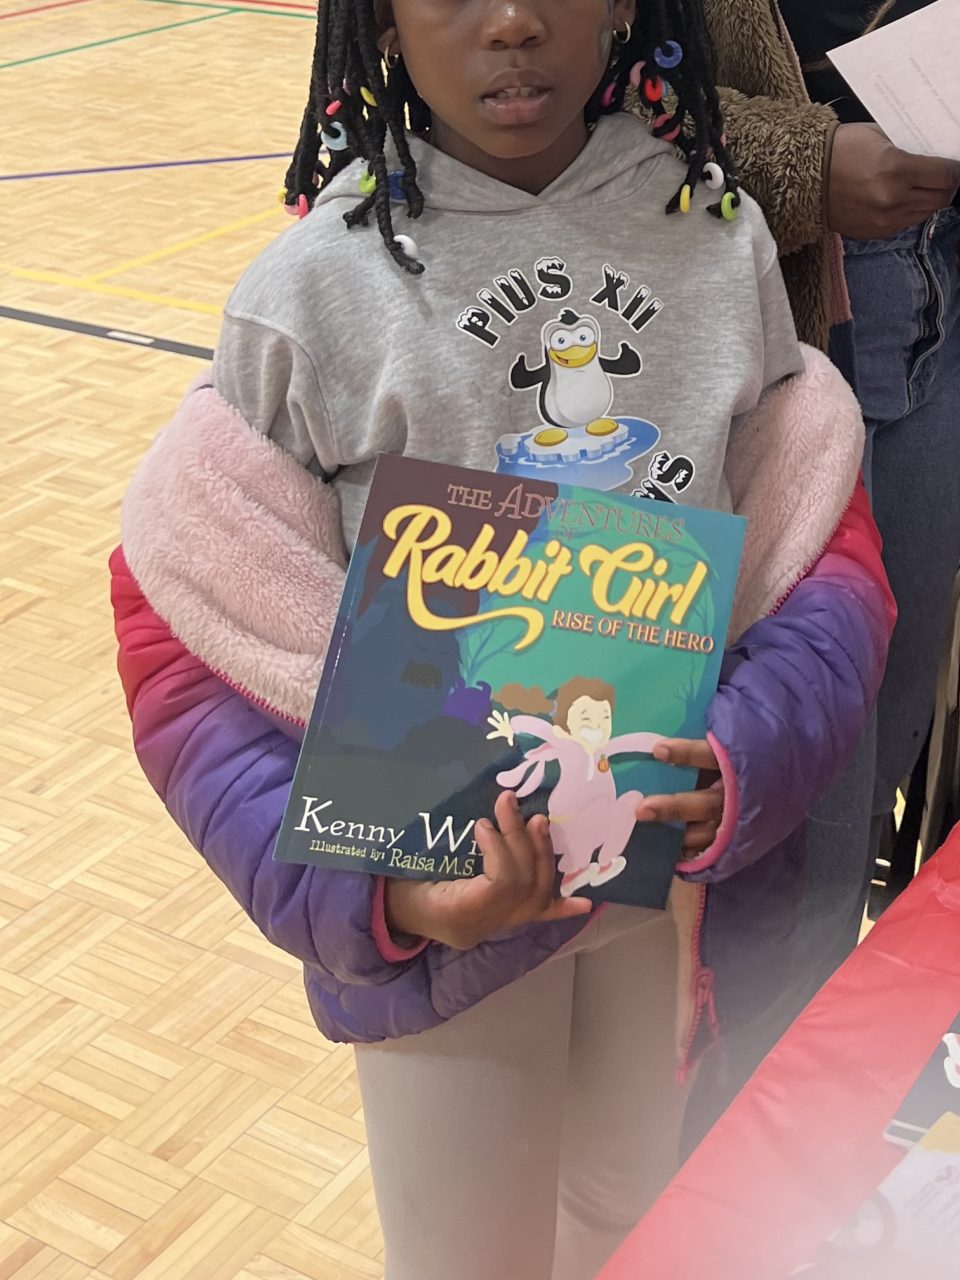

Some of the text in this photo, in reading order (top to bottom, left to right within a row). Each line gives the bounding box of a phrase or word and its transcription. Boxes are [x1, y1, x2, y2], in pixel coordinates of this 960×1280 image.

[455, 256, 664, 349] PIUS XII
[447, 483, 686, 542] THE ADVENTURES
[382, 502, 709, 652] Rabbit Girl
[552, 609, 715, 655] RISE OF THE HERO
[294, 795, 405, 849] Kenny
[309, 839, 367, 858] Illustrated
[388, 847, 435, 873] Raisa
[438, 854, 476, 877] M.S.
